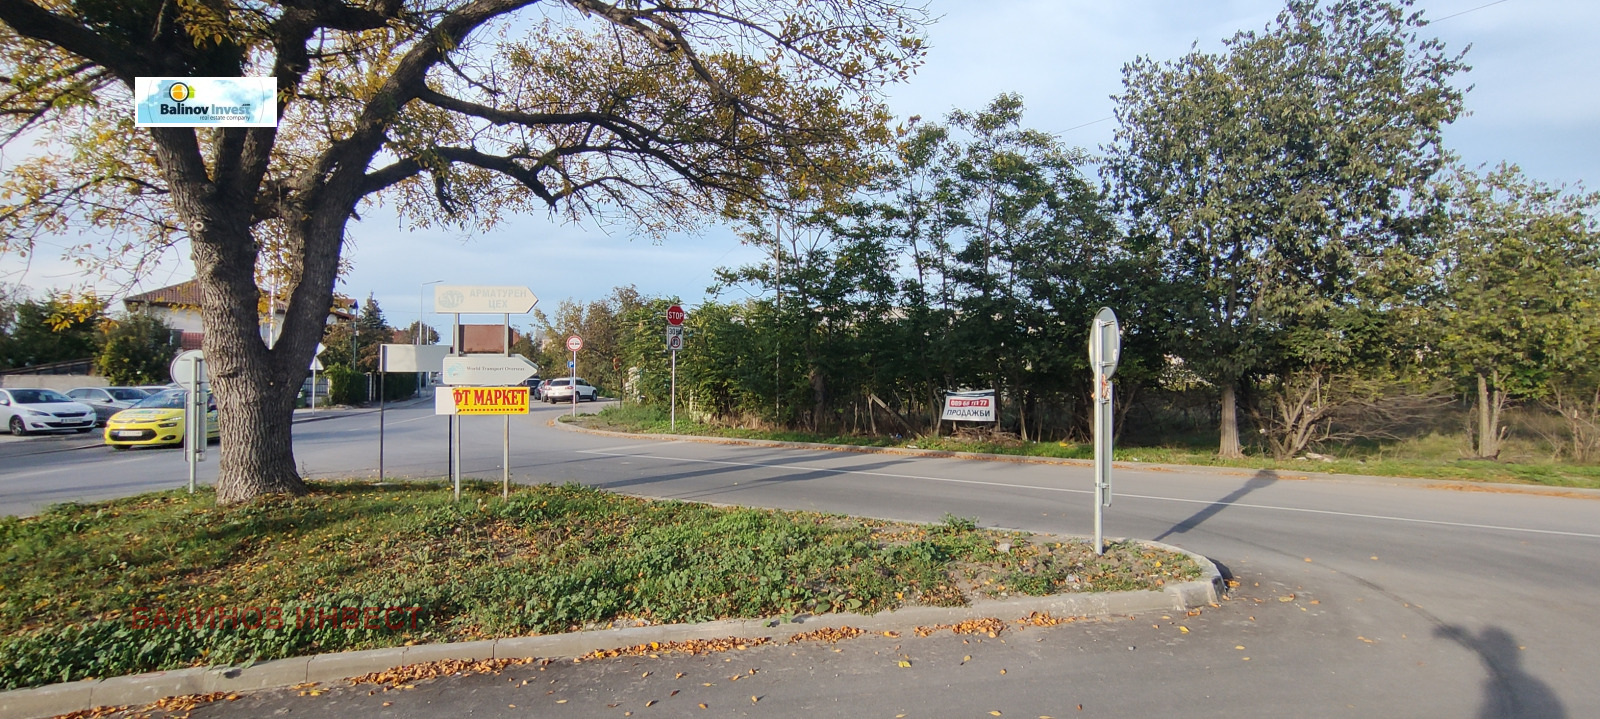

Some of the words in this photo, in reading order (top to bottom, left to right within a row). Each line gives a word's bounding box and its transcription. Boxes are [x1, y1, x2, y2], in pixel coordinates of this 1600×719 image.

[469, 289, 527, 298] АРМАТУРЕН
[488, 300, 508, 309] ЦЕХ
[474, 389, 527, 406] МАРКЕТ
